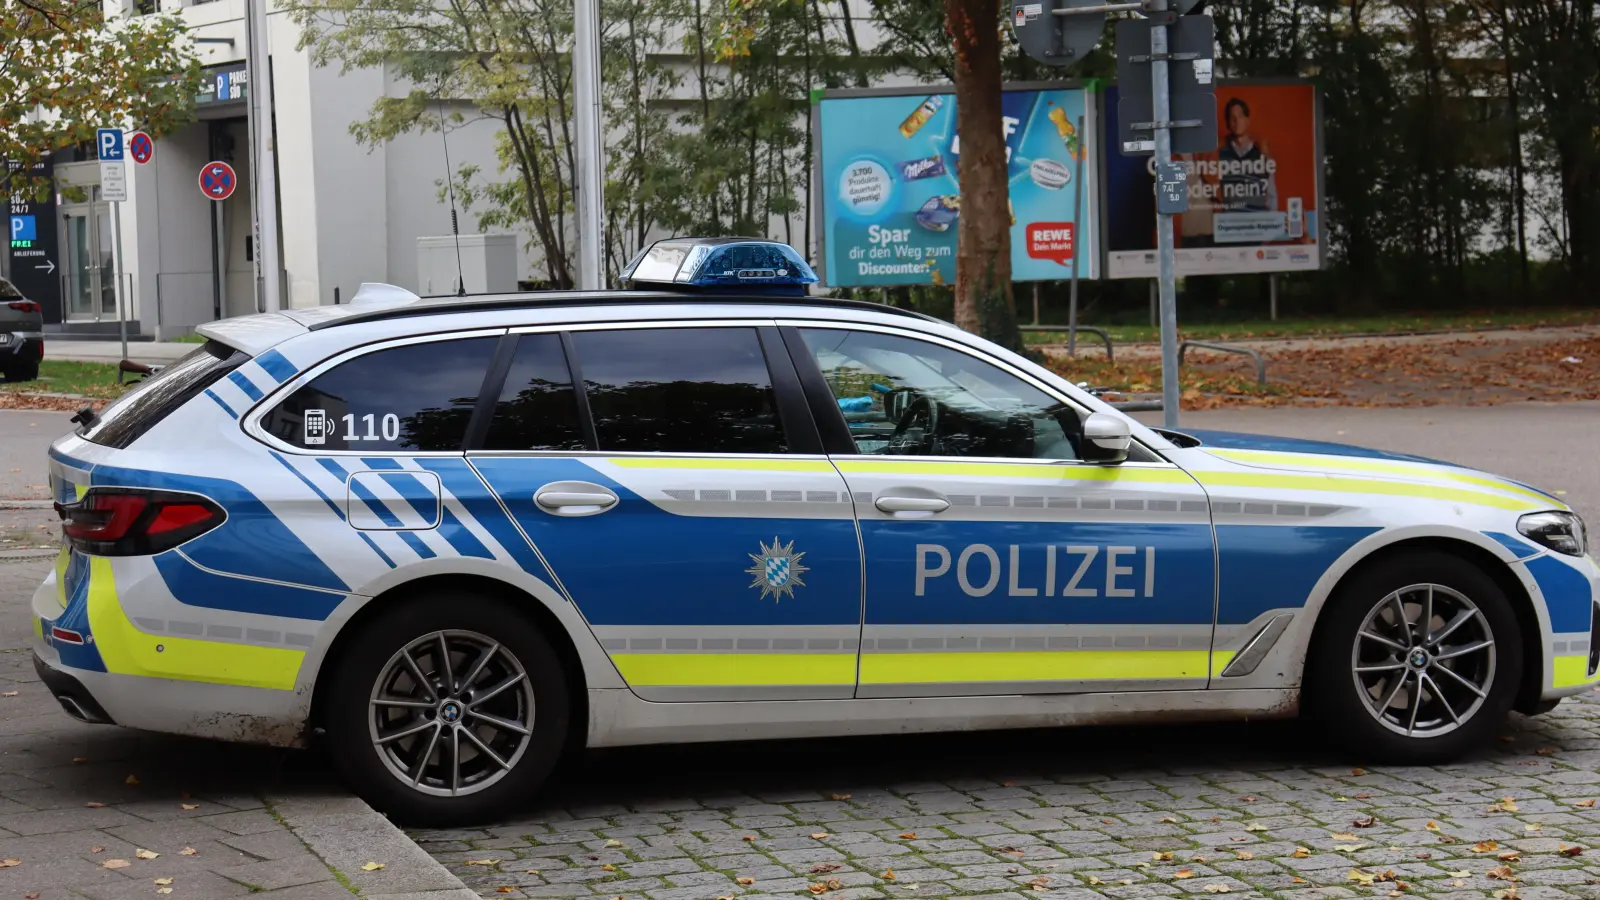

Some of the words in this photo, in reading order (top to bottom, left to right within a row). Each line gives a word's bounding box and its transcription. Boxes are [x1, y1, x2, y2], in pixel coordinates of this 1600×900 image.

[229, 70, 247, 84] PARKE
[1147, 154, 1276, 180] Oanspende
[848, 176, 879, 186] Produkte
[1174, 173, 1187, 181] 150
[849, 184, 881, 195] dauerhaft
[1223, 179, 1268, 198] nein?
[852, 193, 881, 205] günstig!
[11, 205, 28, 213] 24/7
[868, 224, 911, 247] Spar
[1033, 229, 1072, 242] REWE
[11, 240, 32, 248] FREI
[1034, 243, 1050, 251] Dein
[1051, 242, 1072, 251] Markt
[849, 246, 866, 259] dir
[869, 245, 891, 259] den
[894, 244, 921, 260] Weg
[925, 246, 951, 257] zum
[342, 413, 400, 441] 110
[914, 543, 1156, 598] POLIZEI
